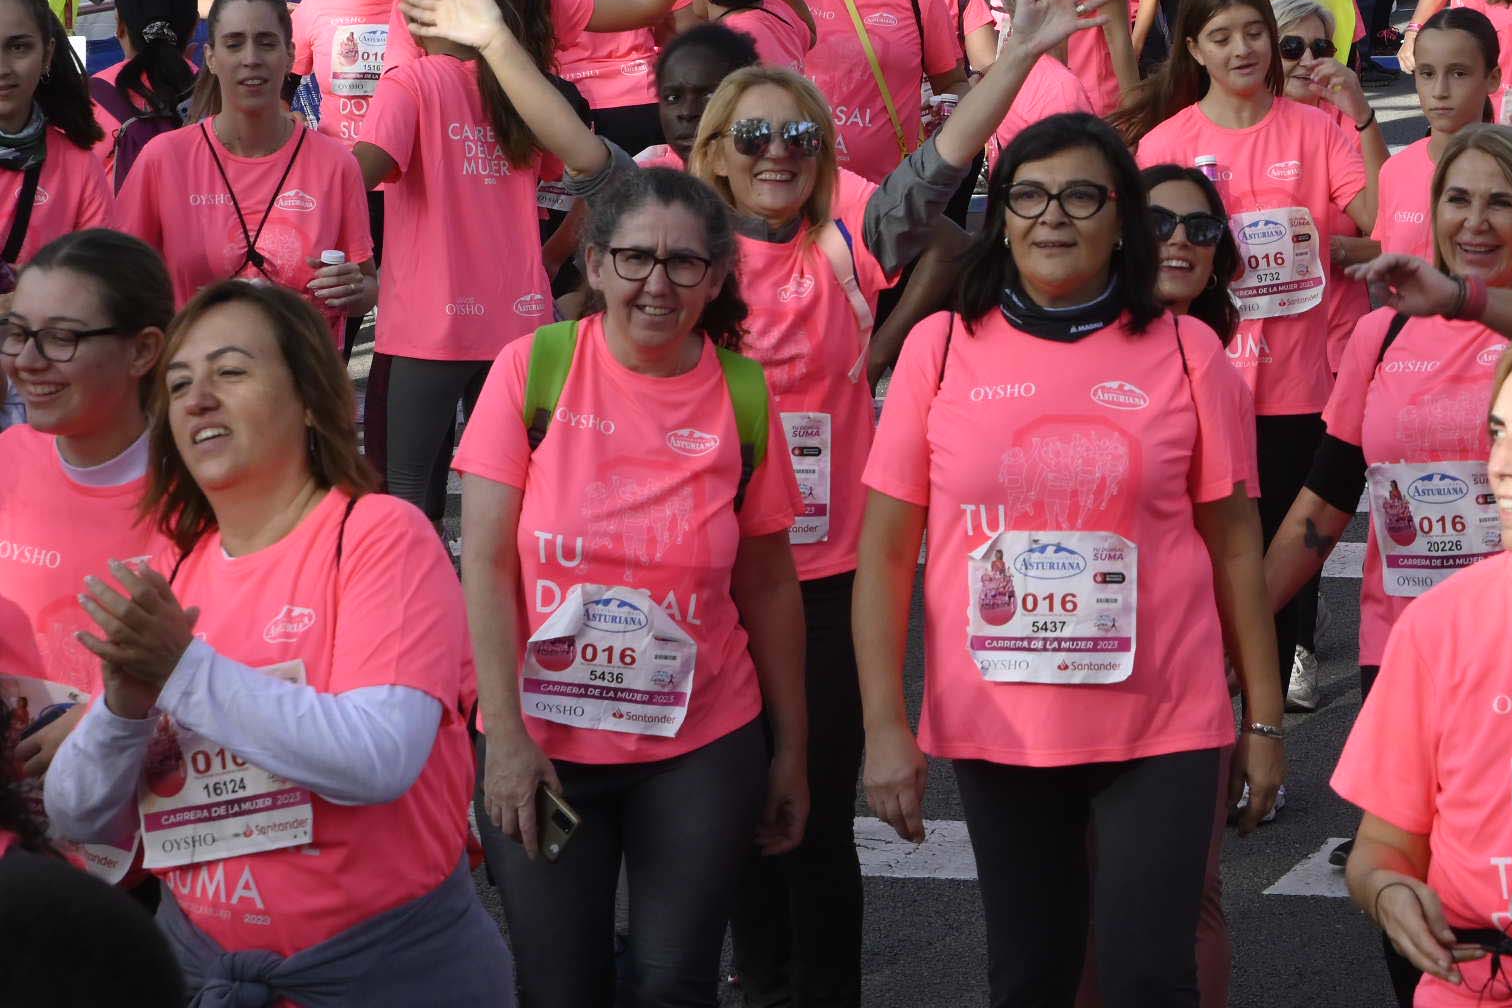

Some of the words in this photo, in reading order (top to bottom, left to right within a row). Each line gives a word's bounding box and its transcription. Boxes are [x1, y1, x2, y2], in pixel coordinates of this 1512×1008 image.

[465, 142, 484, 156] DE
[1242, 228, 1283, 242] ASTURIANA
[1248, 251, 1285, 270] 016
[1257, 272, 1281, 283] 9732
[971, 382, 1036, 402] OYSHO
[1096, 389, 1145, 405] ASTURIANA
[556, 407, 616, 436] OYSHO
[1413, 486, 1463, 497] ASTURIANA
[961, 504, 1006, 537] TU
[1419, 515, 1466, 535] 016
[535, 532, 583, 567] TU
[1427, 540, 1462, 552] 20226
[1020, 557, 1081, 571] ASTURIANA
[1093, 553, 1124, 561] SUMA
[1397, 576, 1433, 587] OYSHO
[1022, 593, 1078, 613] 016
[584, 608, 643, 627] ASTURIANA
[1032, 621, 1066, 633] 5437
[985, 640, 1028, 648] CARRERA
[1031, 640, 1043, 649] DE
[1046, 641, 1058, 649] LA
[1061, 641, 1093, 649] MUJER
[1097, 641, 1118, 649] 2023
[581, 643, 637, 666] 016
[980, 659, 1029, 671] OYSHO
[1071, 661, 1120, 671] Santander
[589, 670, 624, 684] 5436
[540, 683, 585, 695] CARRERA
[587, 687, 601, 696] DE
[603, 689, 615, 697] LA
[618, 691, 649, 702] MUJER
[653, 695, 674, 703] 2023
[536, 700, 585, 718] OYSHO
[626, 710, 675, 724] Santander
[203, 778, 247, 799] 16124
[161, 809, 209, 825] CARRERA
[211, 805, 227, 817] DE
[228, 803, 241, 814] LA
[242, 798, 273, 811] MUJER
[277, 792, 301, 804] 2023
[161, 832, 216, 853] OYSHO
[256, 817, 309, 836] Santander
